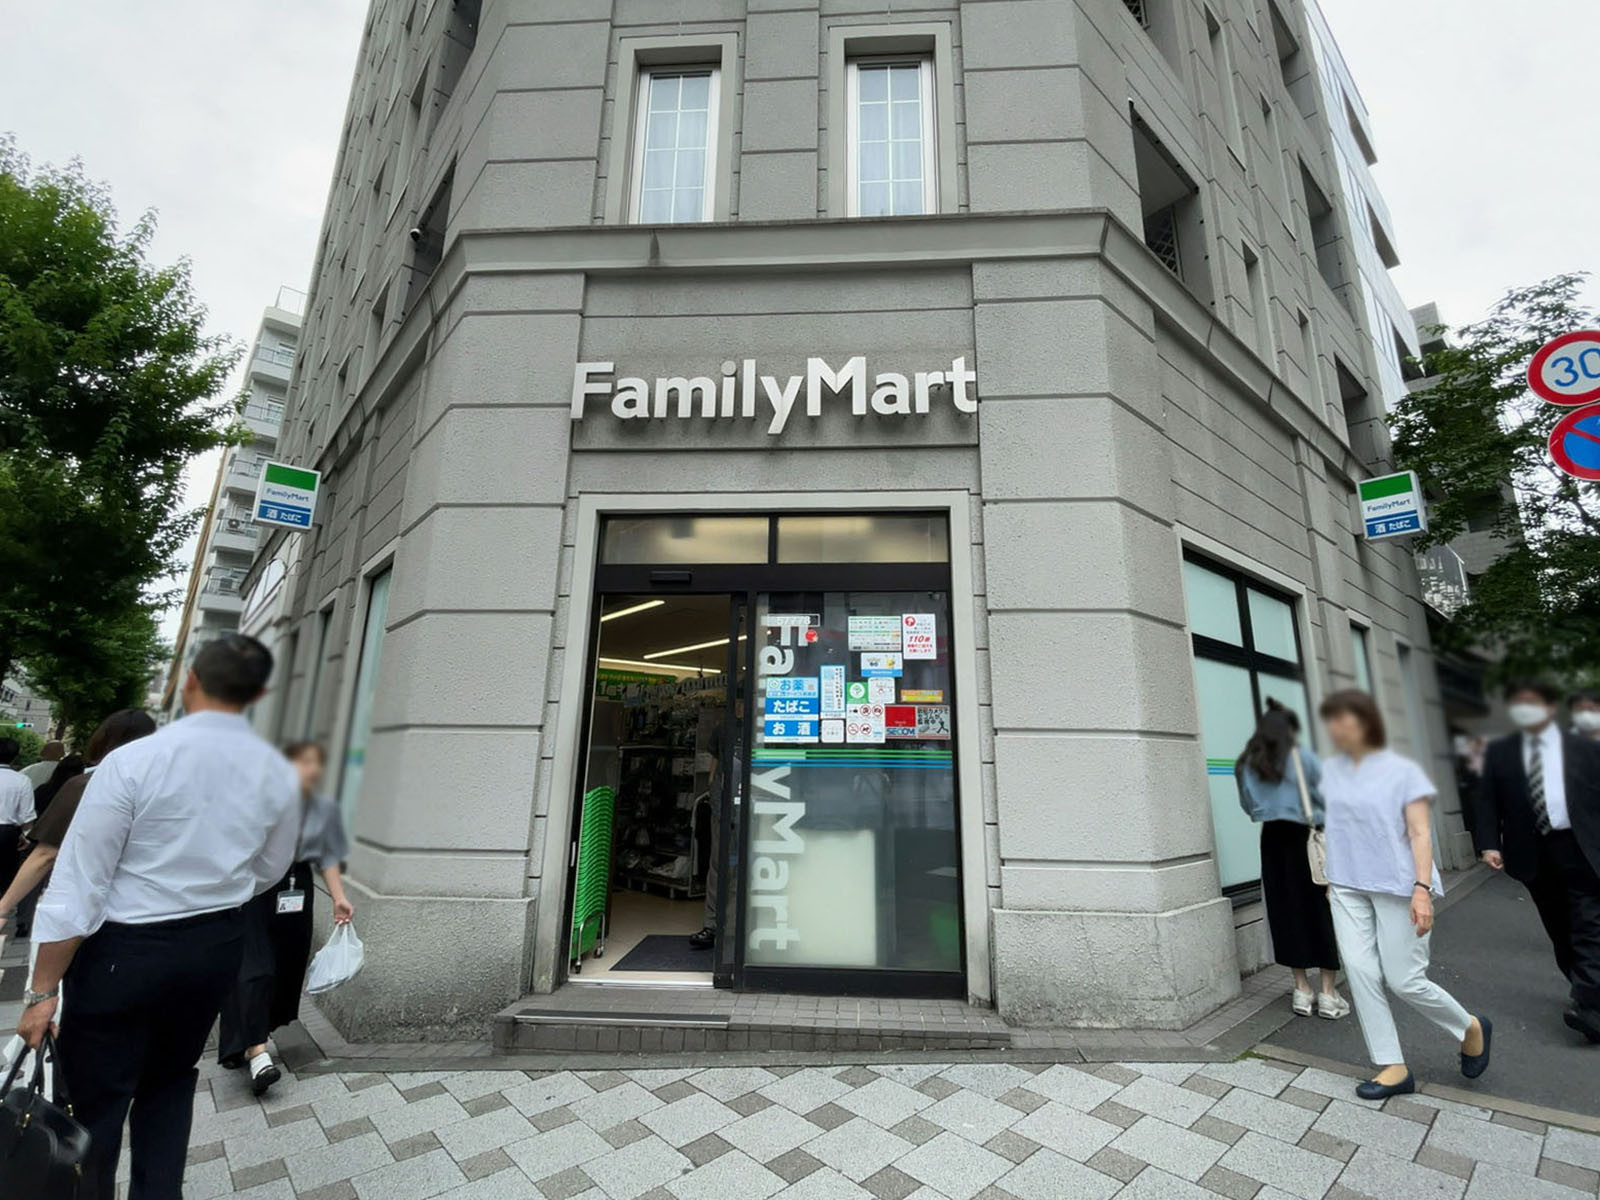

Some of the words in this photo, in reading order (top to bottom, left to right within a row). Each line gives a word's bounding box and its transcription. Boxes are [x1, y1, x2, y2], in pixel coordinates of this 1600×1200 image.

[1551, 347, 1600, 387] 30
[570, 356, 978, 435] FamilyMart
[266, 488, 309, 501] FamilyMart
[1367, 499, 1410, 512] FamilyMart
[266, 509, 278, 519] 酒
[280, 512, 302, 523] たばこ
[1375, 523, 1386, 533] 酒
[1389, 520, 1411, 531] たばこ
[773, 700, 810, 713] たばこ
[886, 727, 916, 736] SECOM
